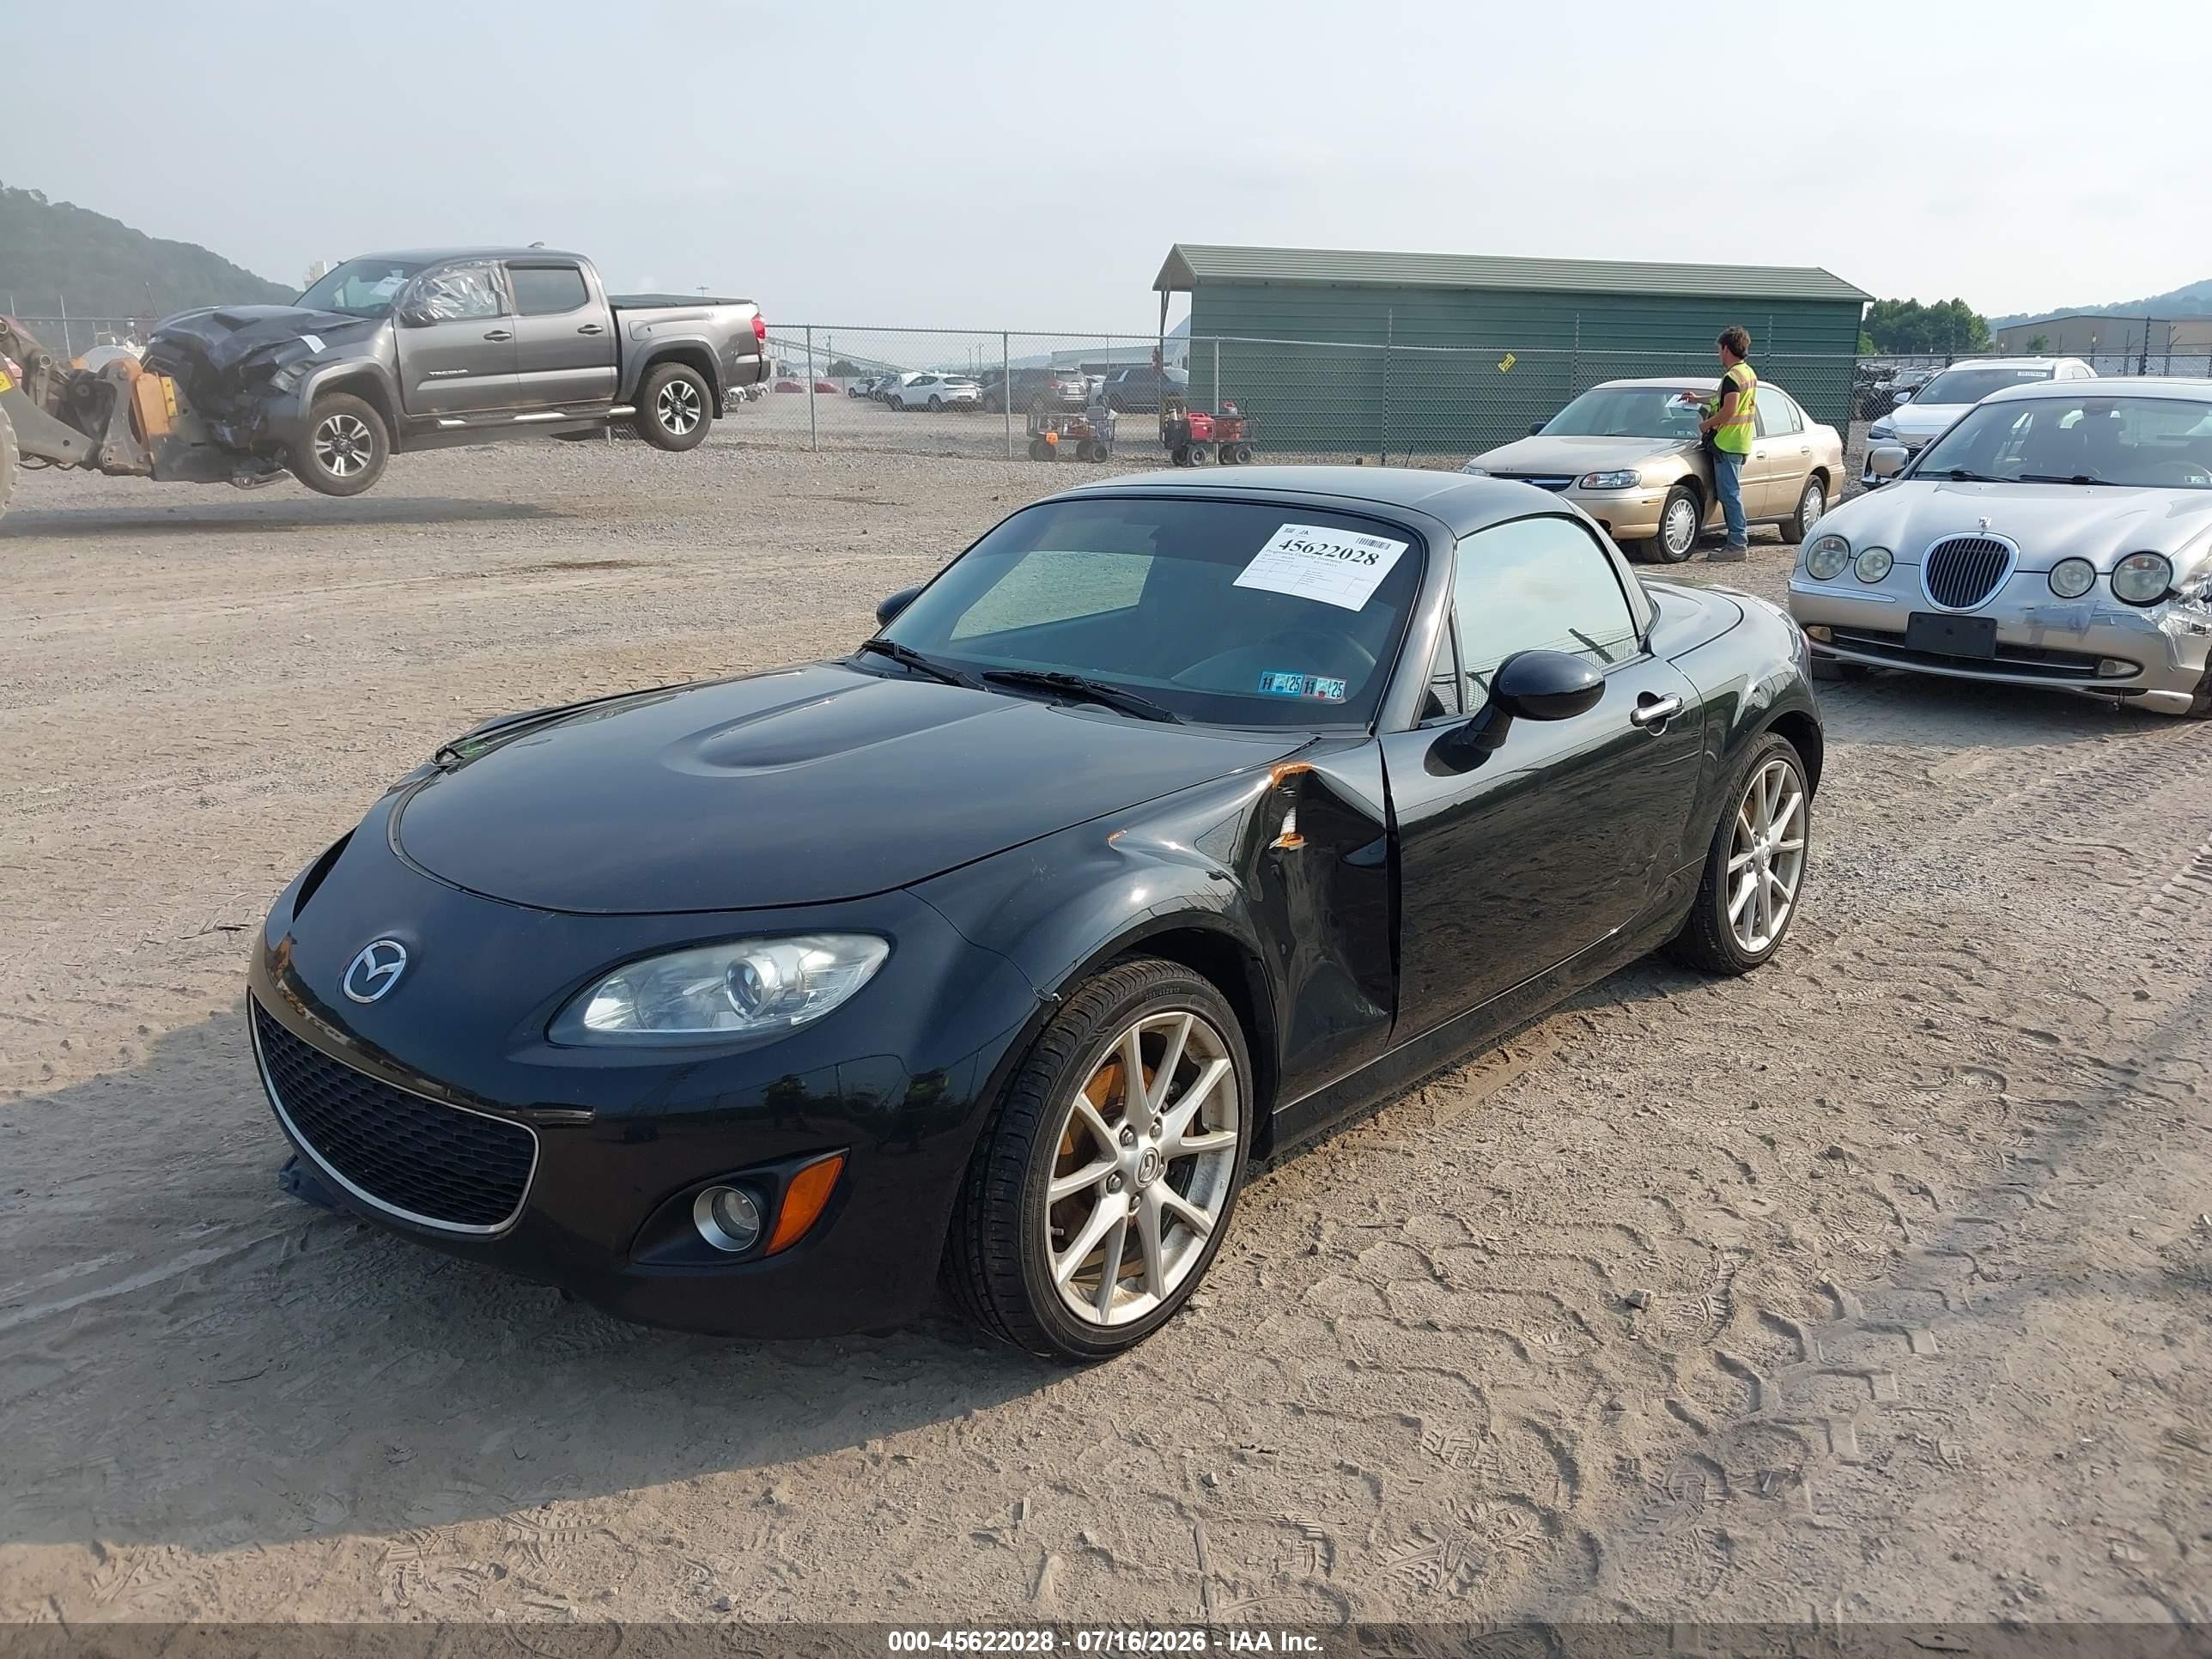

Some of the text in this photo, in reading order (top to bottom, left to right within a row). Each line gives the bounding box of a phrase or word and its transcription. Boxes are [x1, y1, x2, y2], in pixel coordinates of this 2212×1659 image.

[1279, 538, 1379, 566] 45622028
[1288, 676, 1302, 692] 25
[1304, 681, 1344, 698] 11 25
